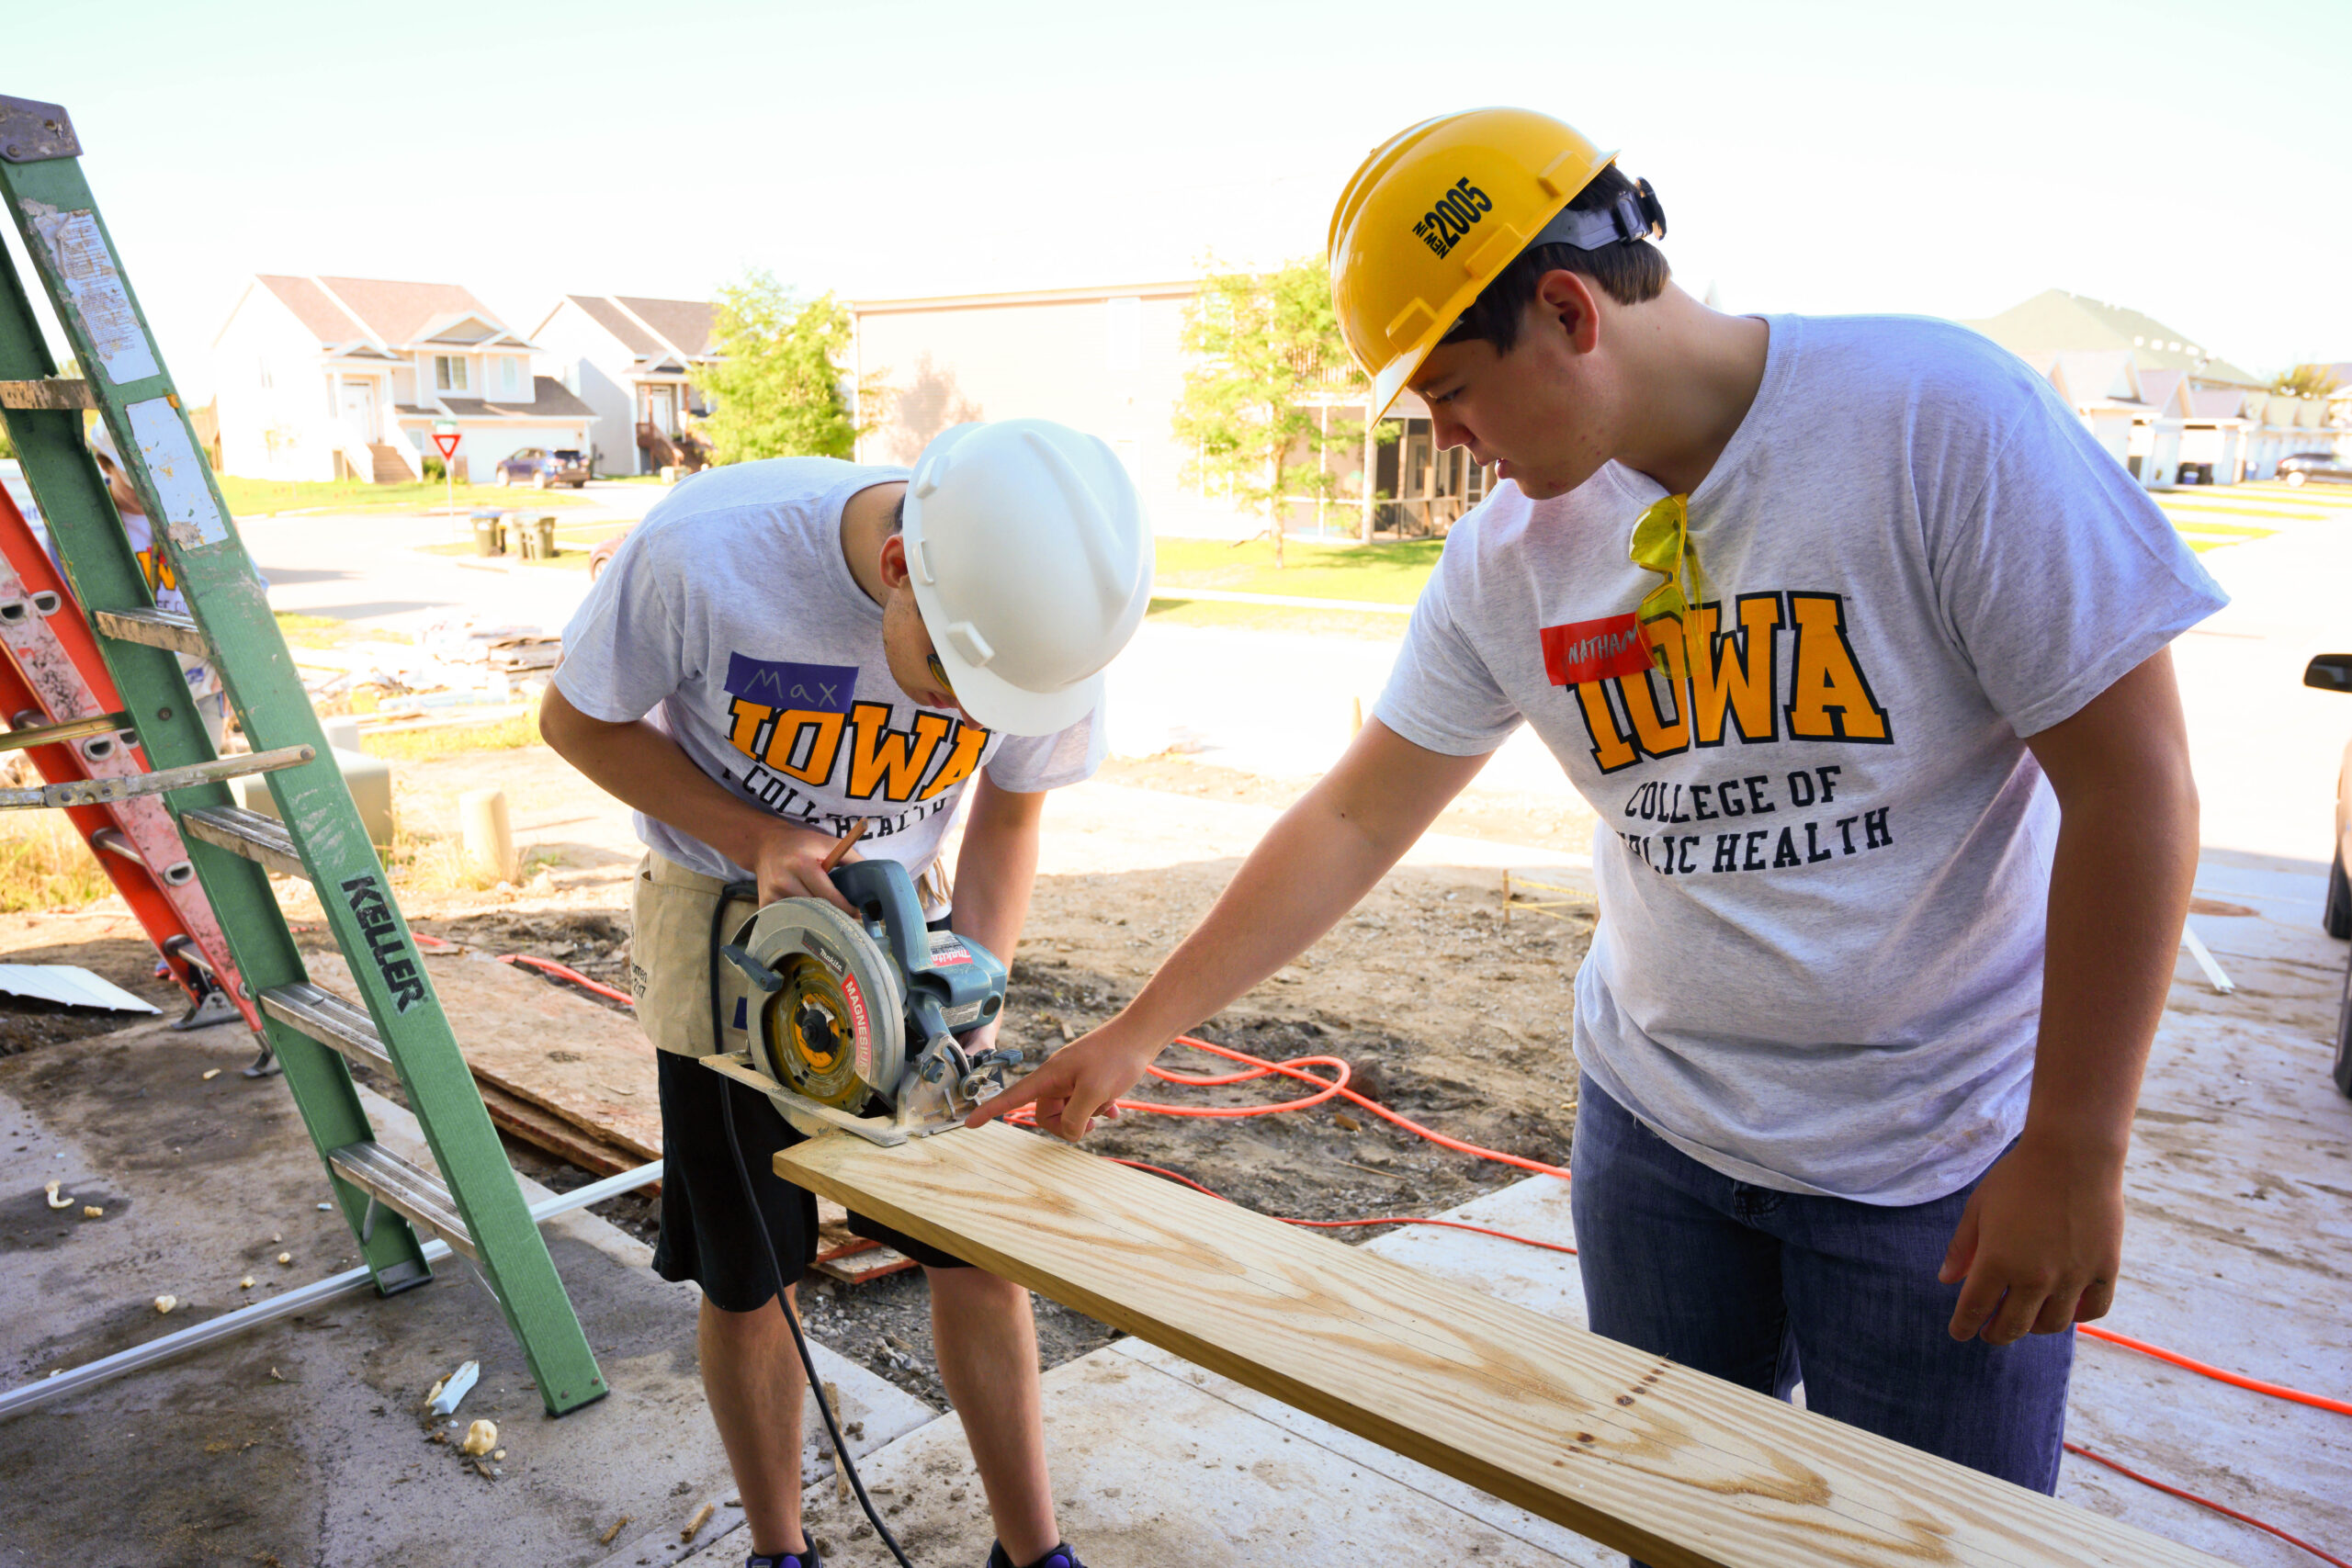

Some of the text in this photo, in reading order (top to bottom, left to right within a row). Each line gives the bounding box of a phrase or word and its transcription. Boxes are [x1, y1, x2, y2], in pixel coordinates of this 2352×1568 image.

[1412, 220, 1450, 260] NEW IN
[1424, 176, 1492, 249] 2005
[1568, 624, 1637, 665] NATHAN
[744, 659, 838, 707] Max
[1566, 591, 1894, 774] IOWA
[725, 694, 992, 802] IOWA
[1624, 765, 1841, 824] COLLEGE OF
[1713, 807, 1894, 873] HEALTH
[341, 875, 424, 1013] KELLER
